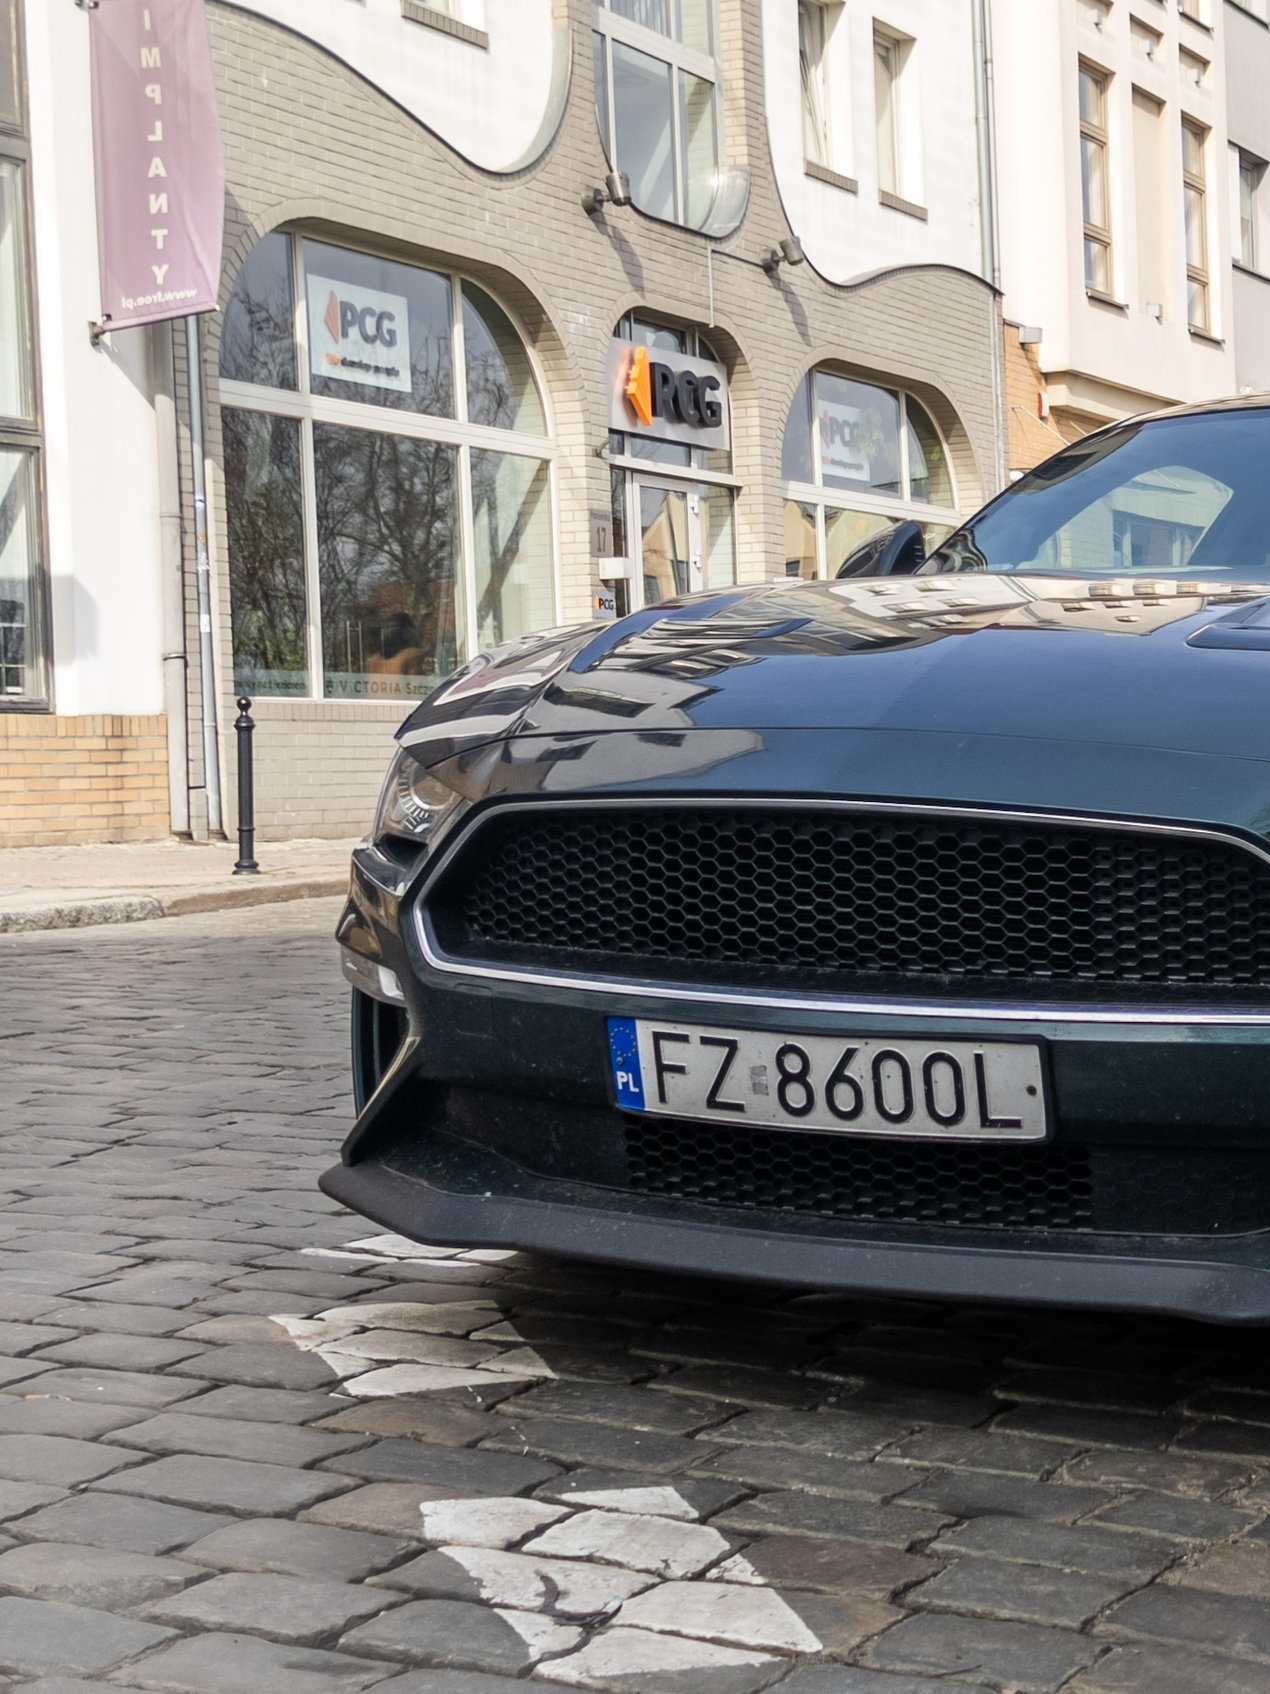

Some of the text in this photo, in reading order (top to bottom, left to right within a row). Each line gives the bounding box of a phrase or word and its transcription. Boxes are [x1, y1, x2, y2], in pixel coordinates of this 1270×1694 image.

[339, 300, 398, 348] PCG
[649, 361, 723, 429] PCG
[598, 598, 614, 610] PCG
[339, 681, 402, 694] VCTORIA
[616, 1070, 640, 1093] PL
[651, 1030, 1023, 1129] FZ 8600L
